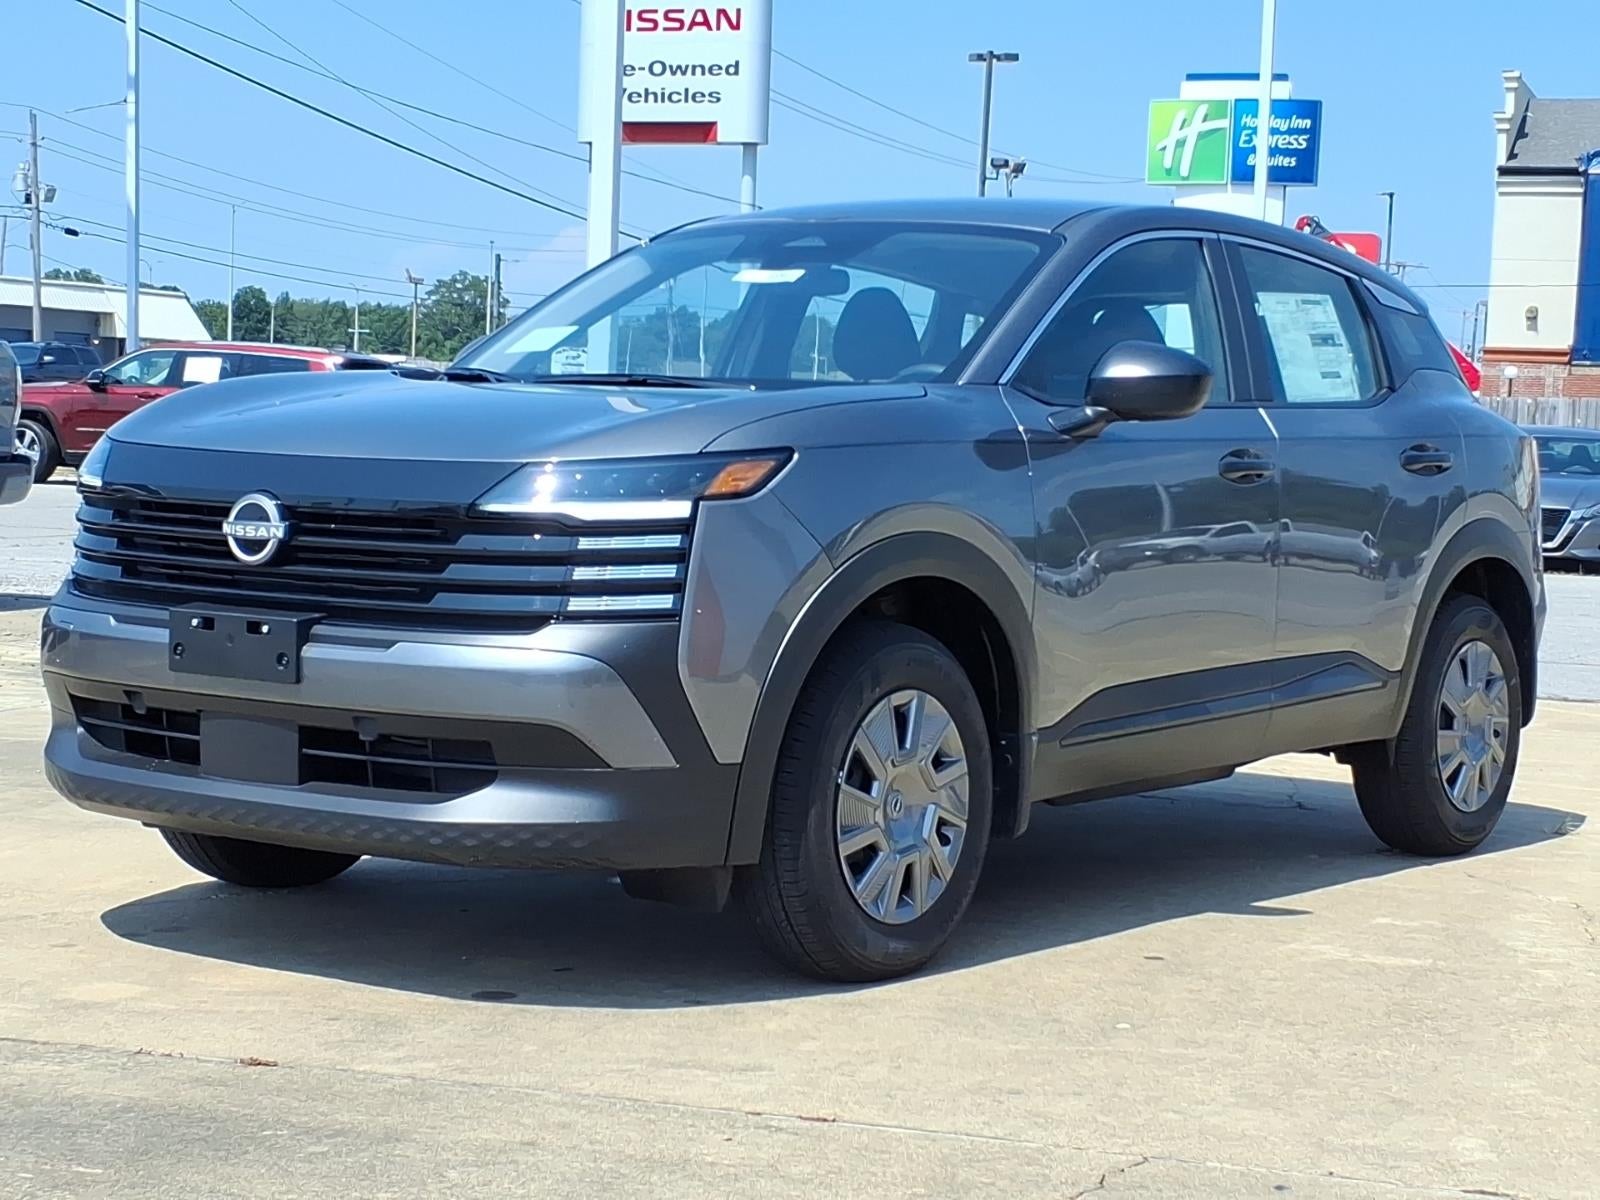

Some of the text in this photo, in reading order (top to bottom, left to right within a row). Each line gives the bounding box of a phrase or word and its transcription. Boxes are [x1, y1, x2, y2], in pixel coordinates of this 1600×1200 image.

[625, 8, 741, 32] ISSAN
[622, 60, 740, 77] e-Owned
[1290, 115, 1312, 129] Inn
[1239, 130, 1310, 149] Exress
[1267, 154, 1297, 167] uites
[222, 522, 284, 538] NISSAN
